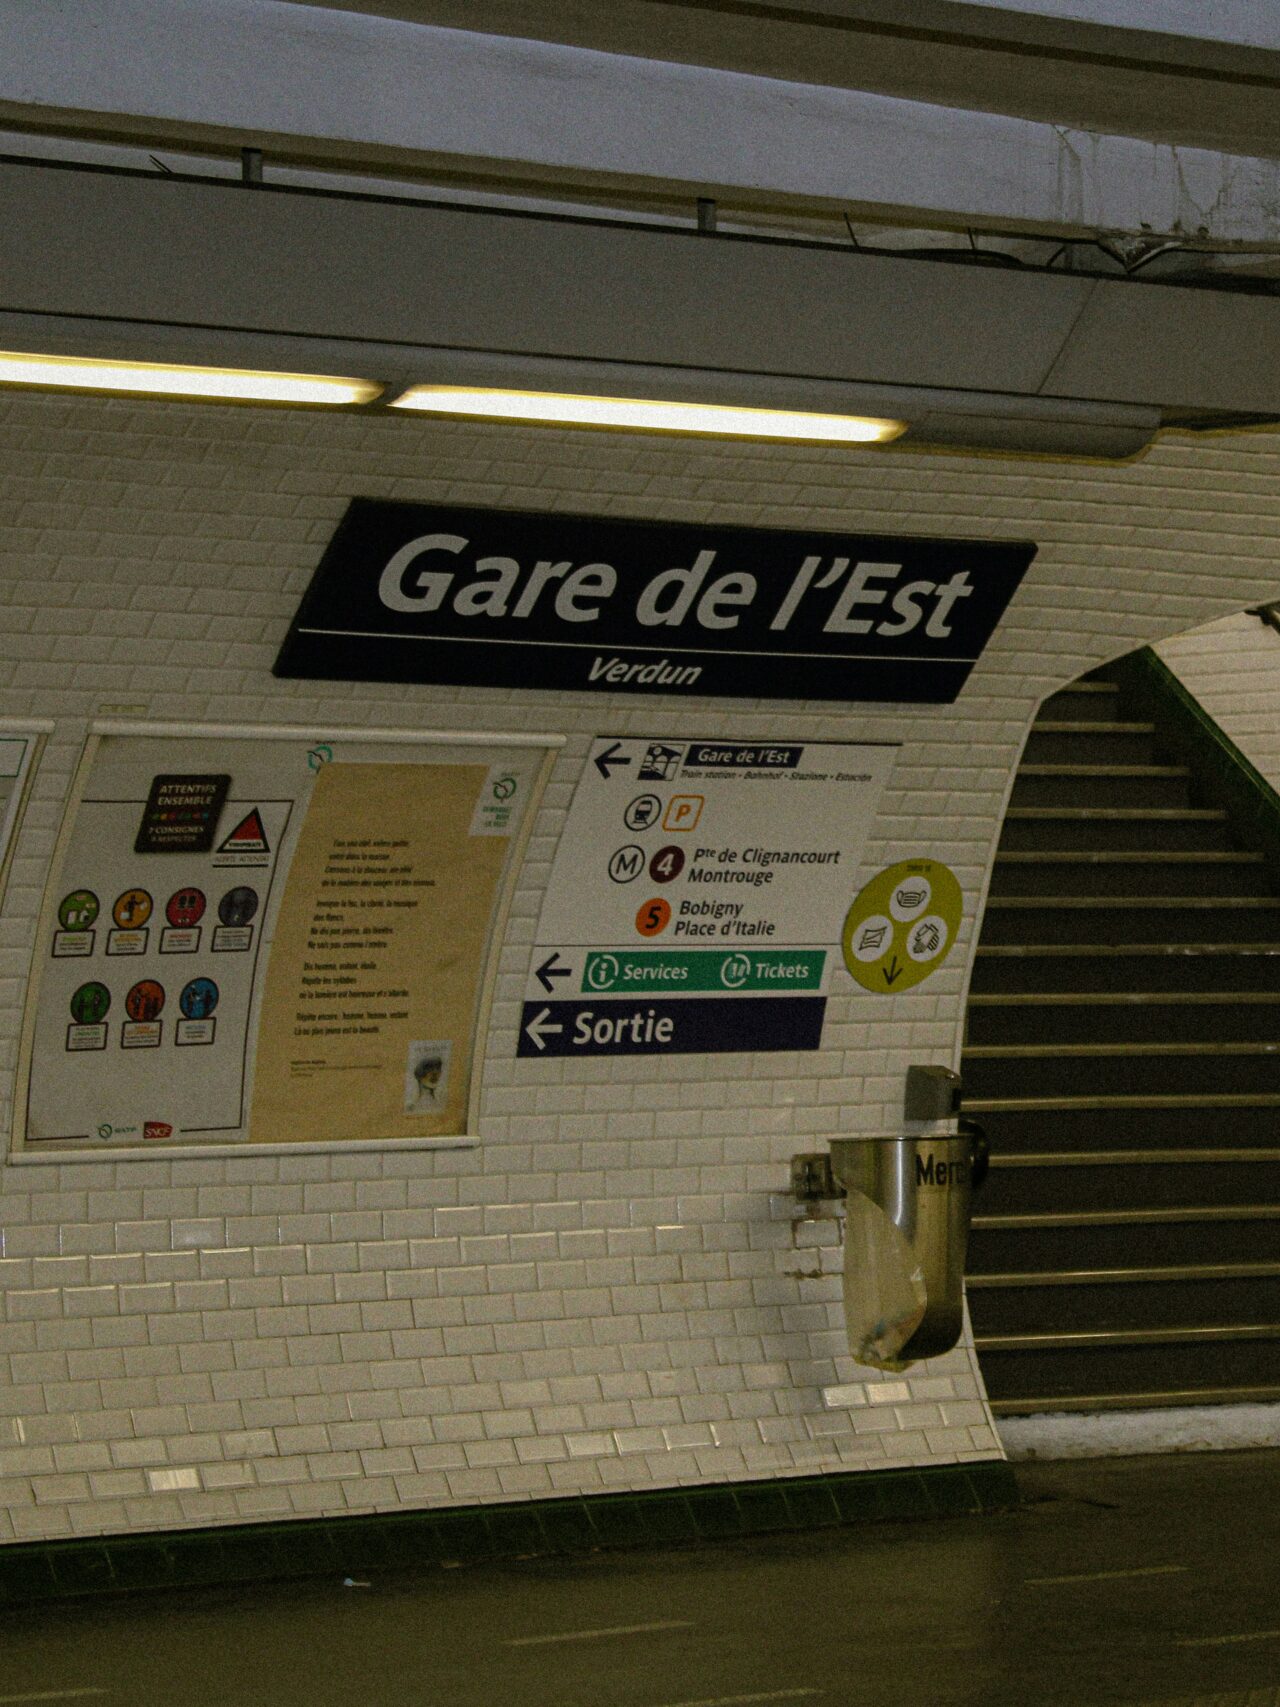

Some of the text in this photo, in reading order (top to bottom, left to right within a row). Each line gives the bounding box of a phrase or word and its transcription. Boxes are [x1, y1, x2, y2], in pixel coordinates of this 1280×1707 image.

[377, 532, 975, 639] Gare de l'Est
[588, 655, 703, 687] Verdun
[698, 749, 791, 764] Gare de l'Est
[680, 769, 702, 779] Train
[704, 769, 737, 779] station
[743, 770, 783, 781] Bahnhof
[788, 771, 828, 782] Stazione
[159, 784, 217, 794] ATTENTIFS
[157, 796, 212, 806] ENSEMBLE
[675, 804, 691, 823] P
[155, 826, 205, 834] CONSIGNES
[657, 853, 673, 876] 4
[718, 849, 737, 863] de
[742, 848, 841, 867] Clignancourt
[688, 869, 774, 887] Montrouge
[645, 901, 744, 930] 5 Bobigny
[674, 921, 776, 937] Place d'Italie
[623, 963, 689, 980] Services
[755, 962, 810, 979] Tickets
[573, 1009, 674, 1046] Sortie
[145, 1127, 171, 1138] SNCF
